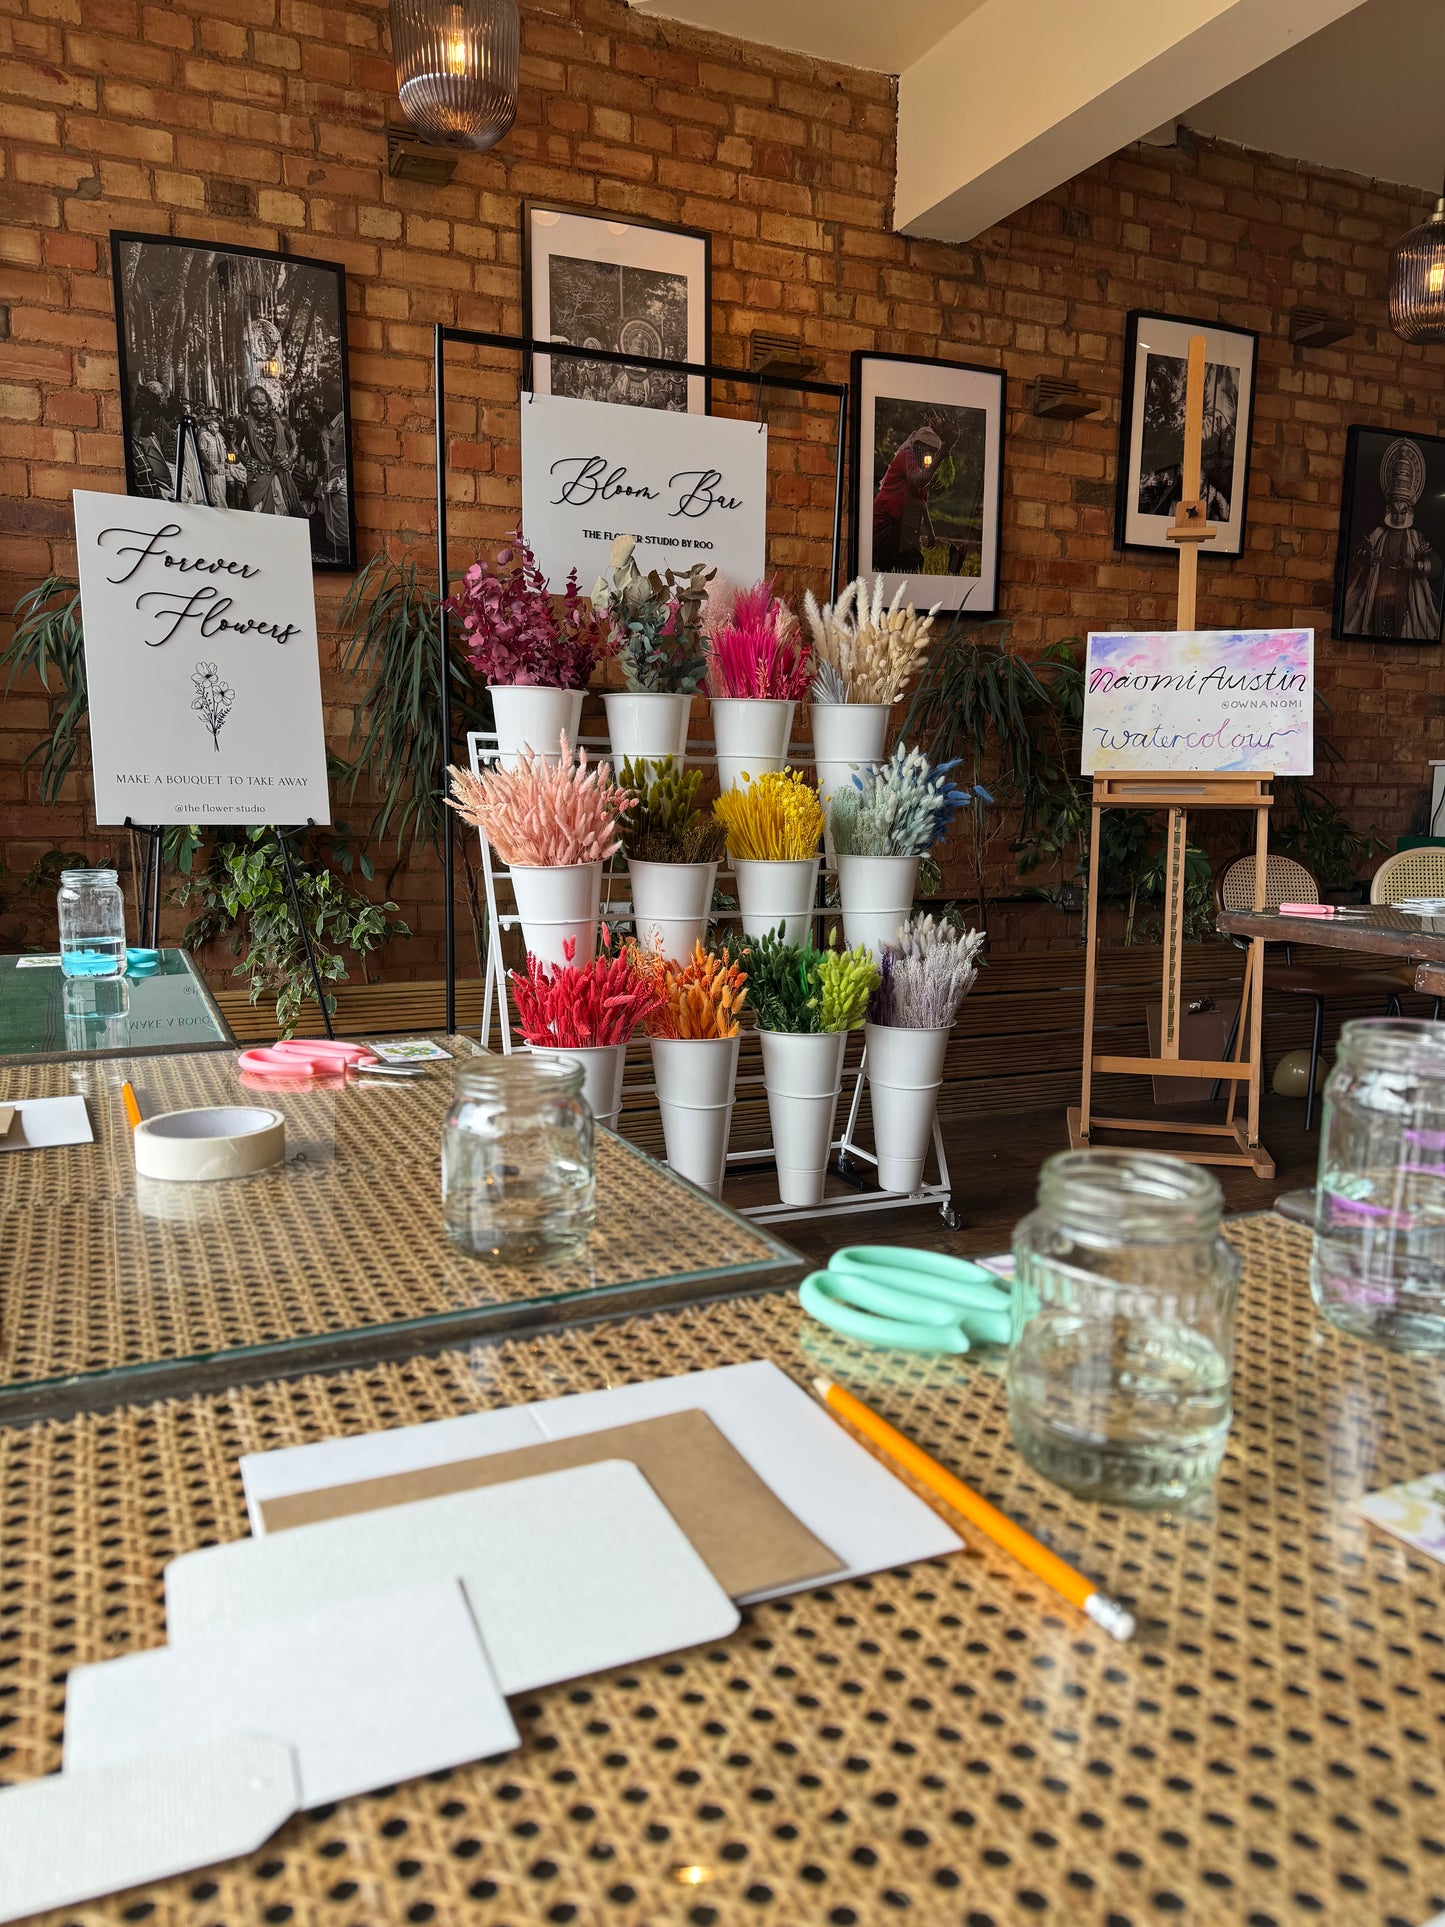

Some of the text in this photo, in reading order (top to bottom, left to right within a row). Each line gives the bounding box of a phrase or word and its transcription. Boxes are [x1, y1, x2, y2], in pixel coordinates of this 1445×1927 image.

[549, 455, 744, 519] Bloom Bar
[97, 523, 262, 585] Forever
[581, 529, 603, 540] THE
[644, 535, 681, 547] STUDIO
[681, 538, 694, 548] BY
[693, 539, 715, 550] ROO
[135, 585, 303, 648] Flowers
[1197, 664, 1307, 696] Austin
[115, 774, 309, 788] MAKE A BOUQUET TO TAKE AWAY
[174, 803, 266, 814] @the flower studio
